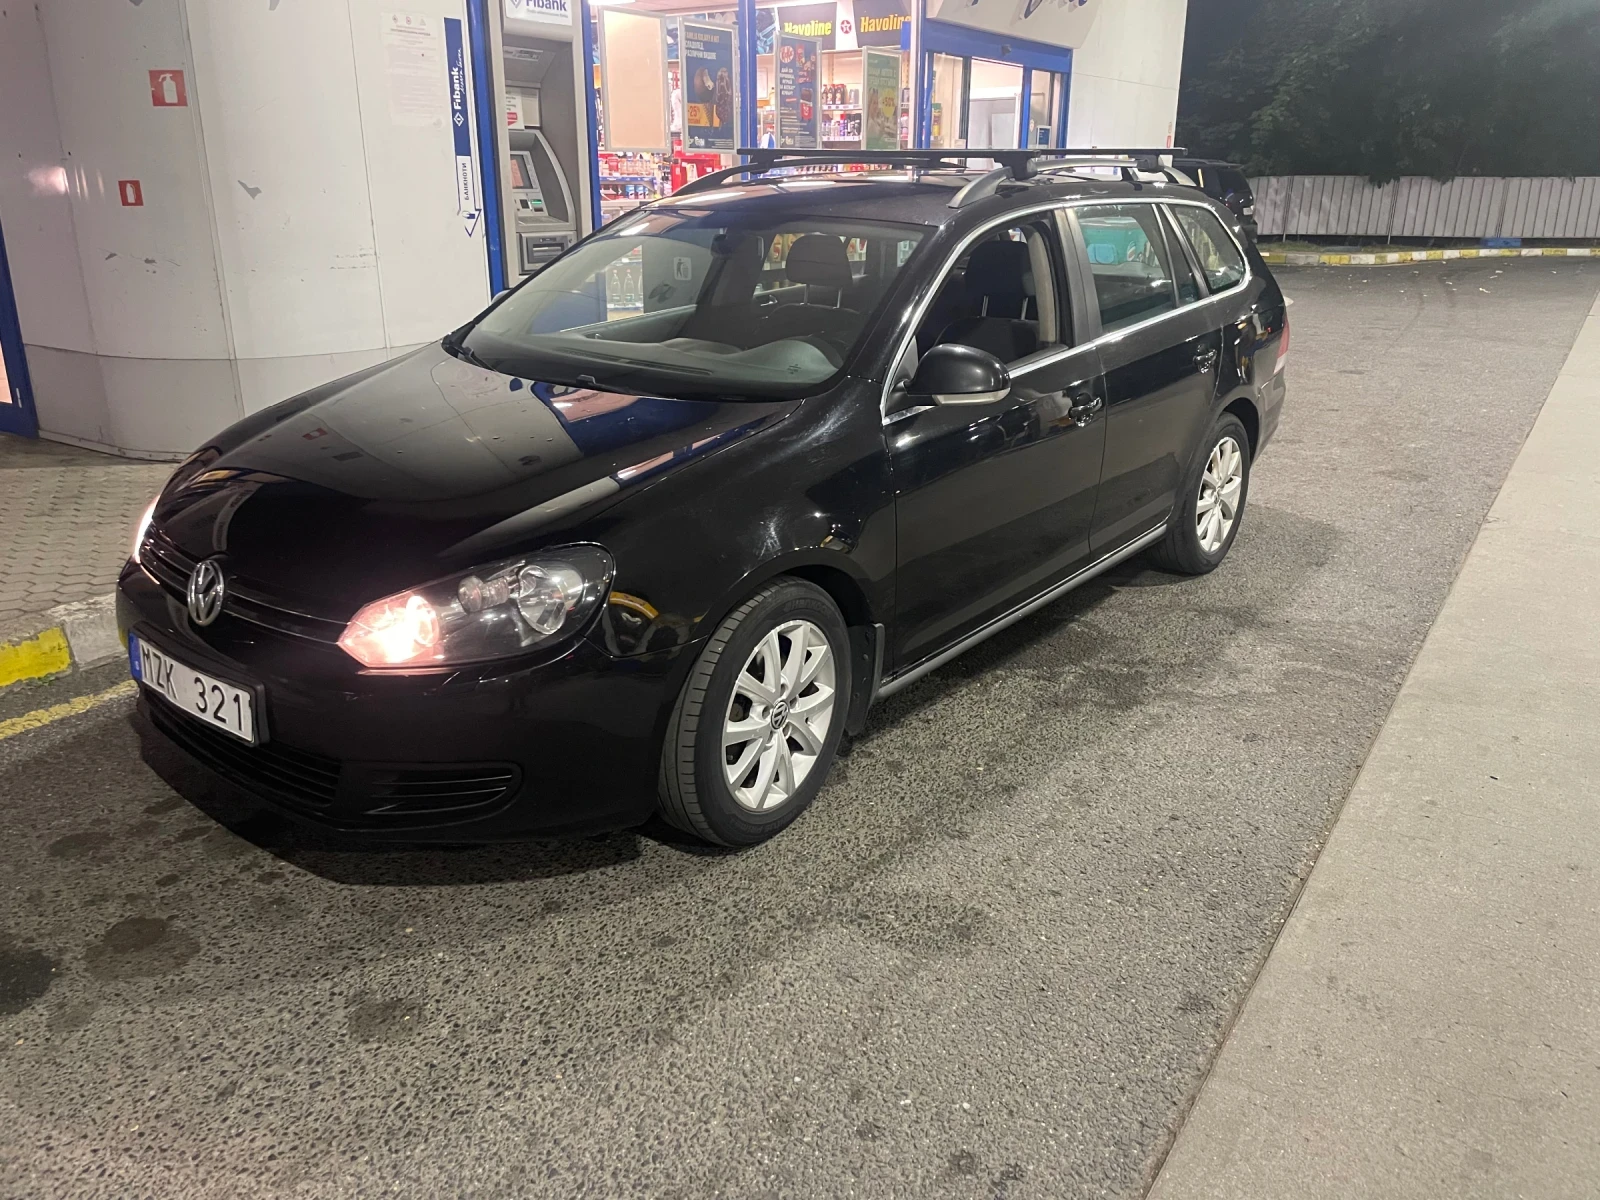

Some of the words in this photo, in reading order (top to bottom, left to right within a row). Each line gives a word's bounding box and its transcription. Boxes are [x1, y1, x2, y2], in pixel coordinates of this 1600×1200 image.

[784, 20, 832, 36] Havoline
[451, 67, 461, 109] Fibank
[142, 644, 178, 700] MZK
[194, 676, 243, 731] 321
